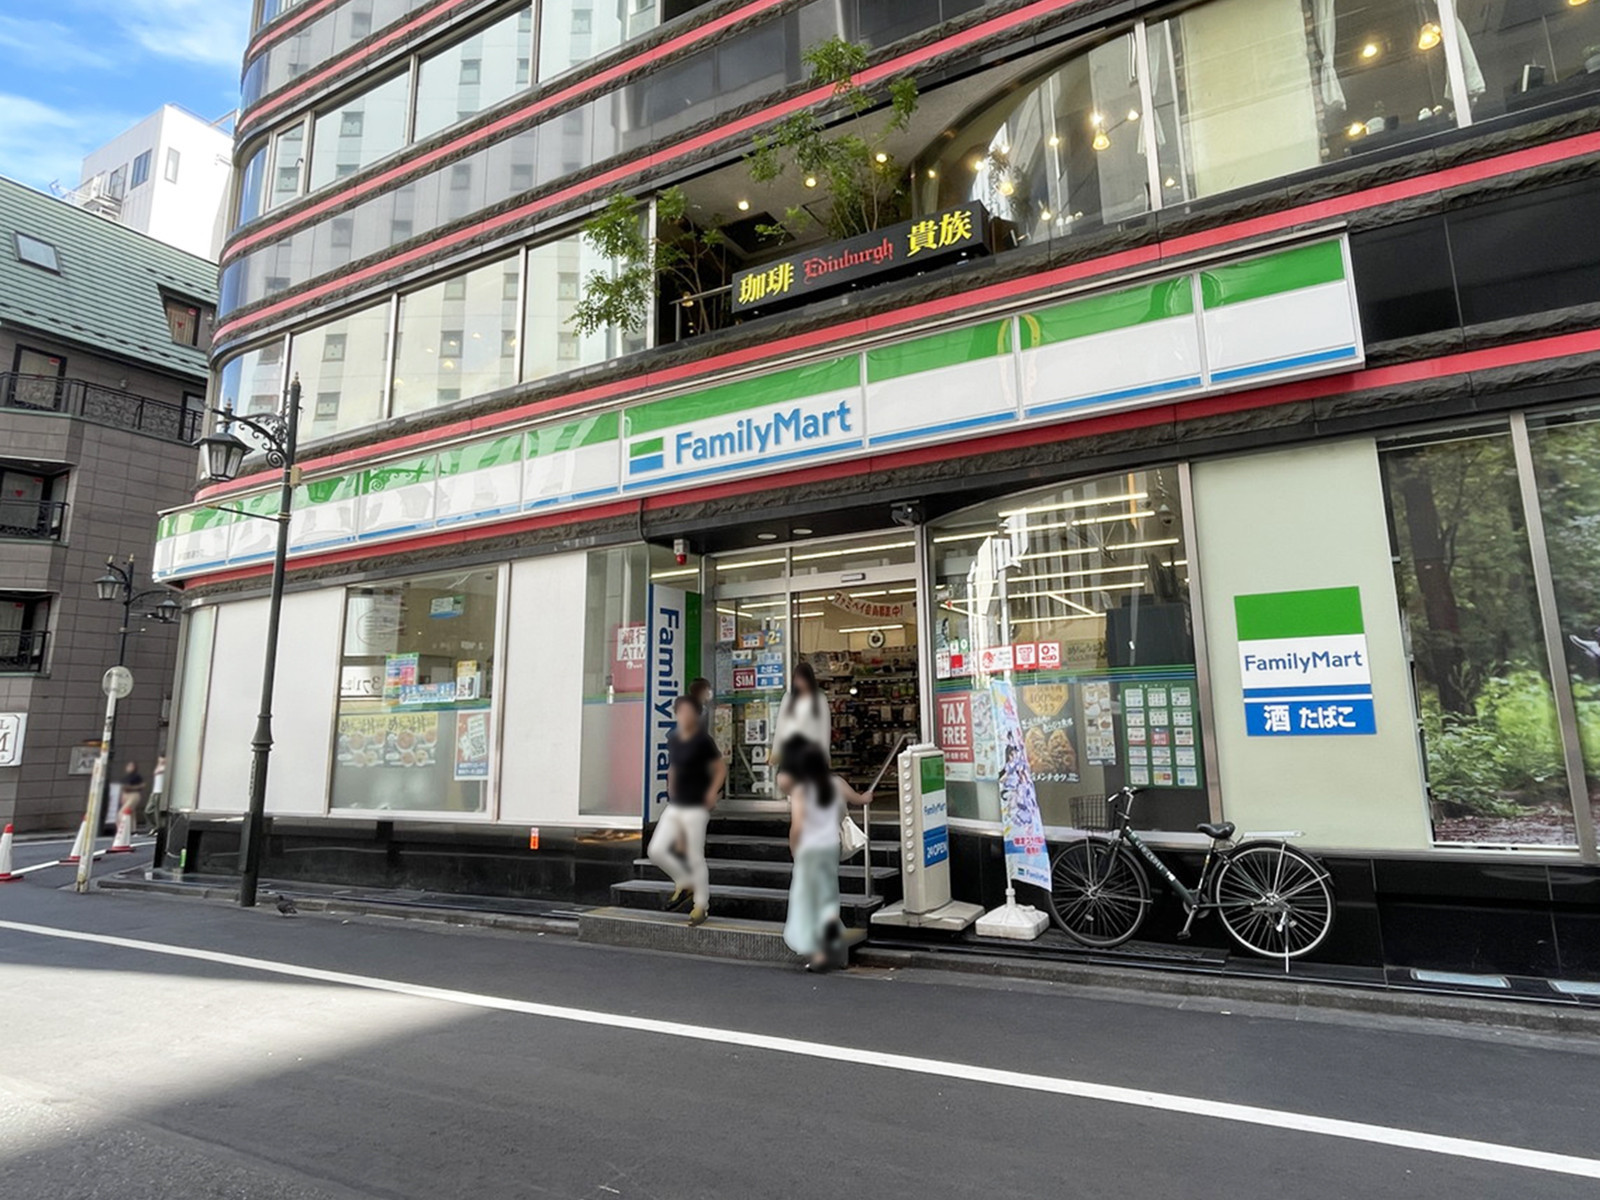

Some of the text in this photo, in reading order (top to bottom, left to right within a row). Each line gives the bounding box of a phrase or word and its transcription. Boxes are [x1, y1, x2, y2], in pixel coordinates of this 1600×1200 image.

[907, 210, 973, 257] 貴族
[803, 237, 894, 285] Edinburgh
[738, 262, 795, 305] 珈琲
[675, 400, 852, 465] FamilyMart
[1244, 651, 1364, 674] FamilyMart
[735, 674, 754, 687] SIM
[941, 702, 966, 724] TAX
[1264, 704, 1357, 732] 酒 たばこ
[942, 726, 968, 745] FREE
